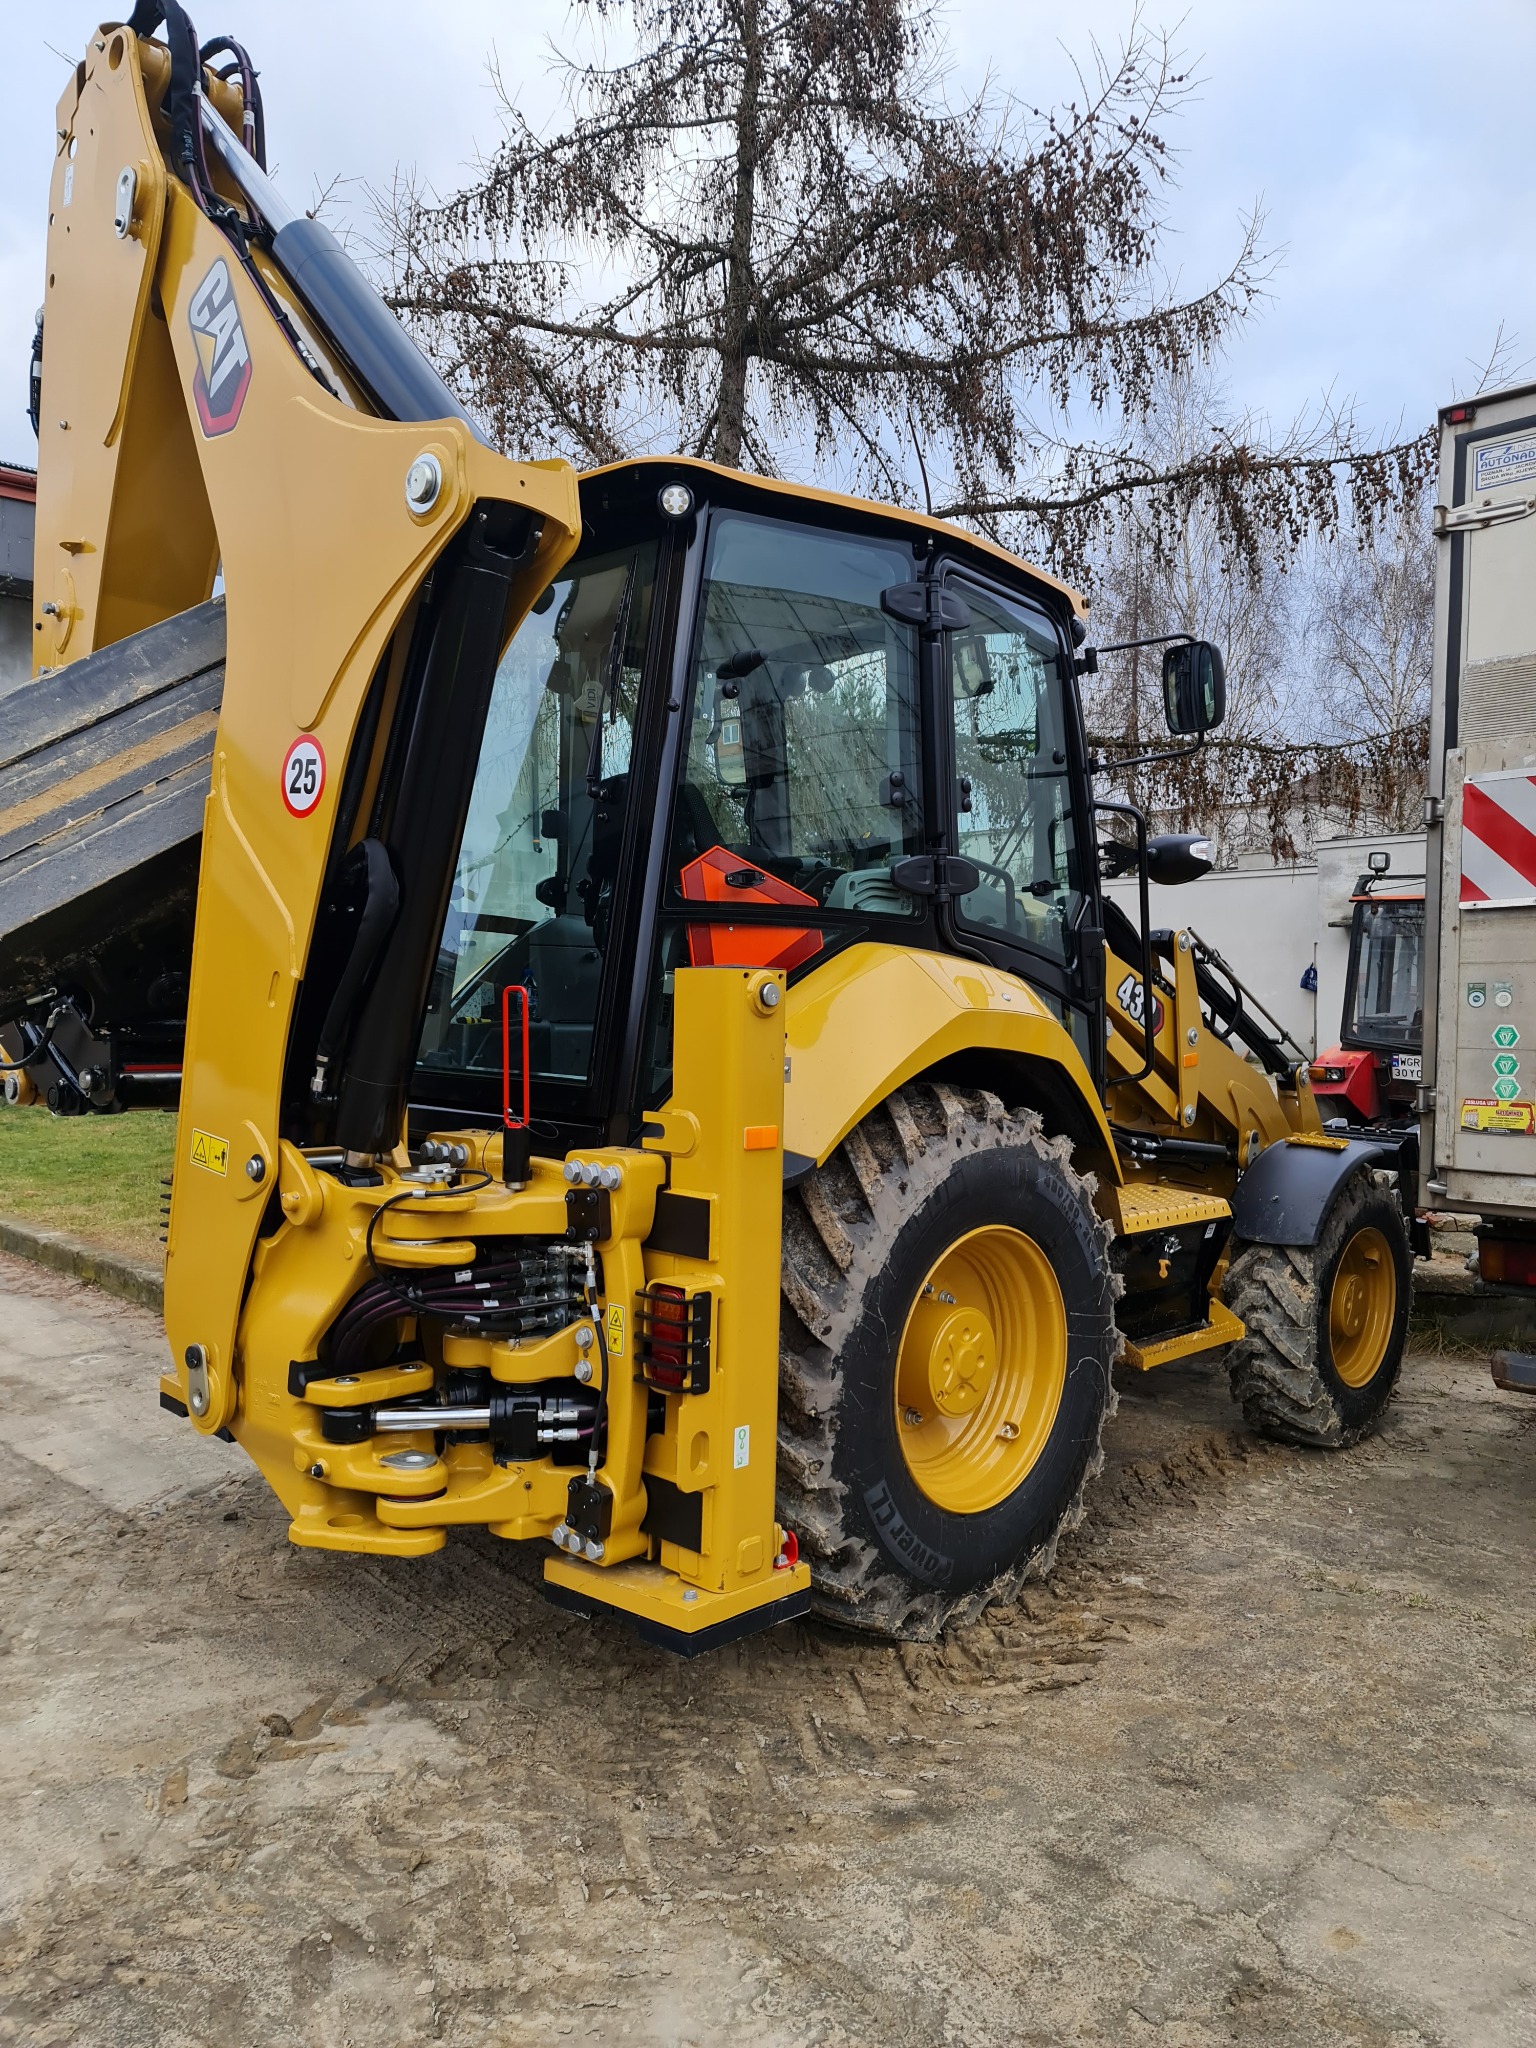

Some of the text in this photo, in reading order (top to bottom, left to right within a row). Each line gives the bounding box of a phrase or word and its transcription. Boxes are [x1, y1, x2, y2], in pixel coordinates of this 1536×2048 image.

[190, 260, 249, 399] CAT
[289, 758, 317, 795] 25
[1400, 1057, 1421, 1067] WGR
[870, 1486, 897, 1527] CL
